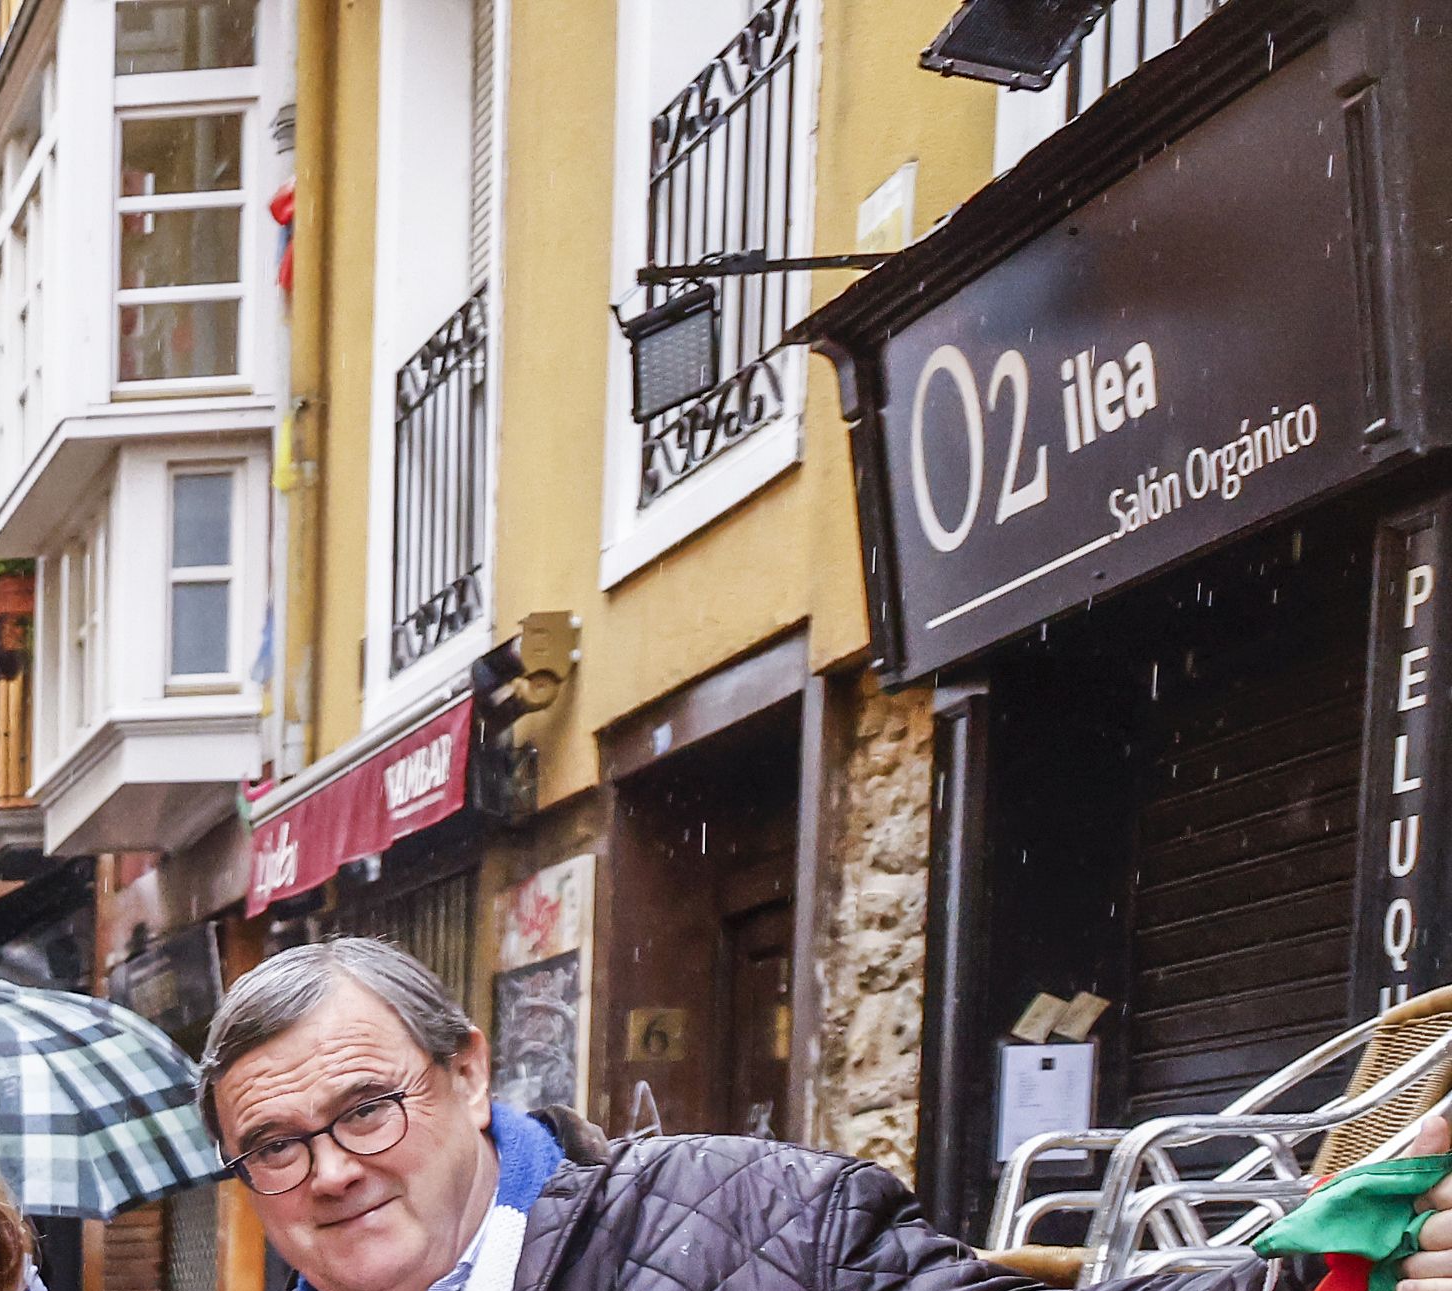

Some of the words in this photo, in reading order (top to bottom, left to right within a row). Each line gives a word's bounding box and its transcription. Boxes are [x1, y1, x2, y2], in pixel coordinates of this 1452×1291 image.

[1060, 341, 1158, 454] ilea
[1108, 465, 1182, 541] Salón
[1185, 402, 1317, 501] Orgánico
